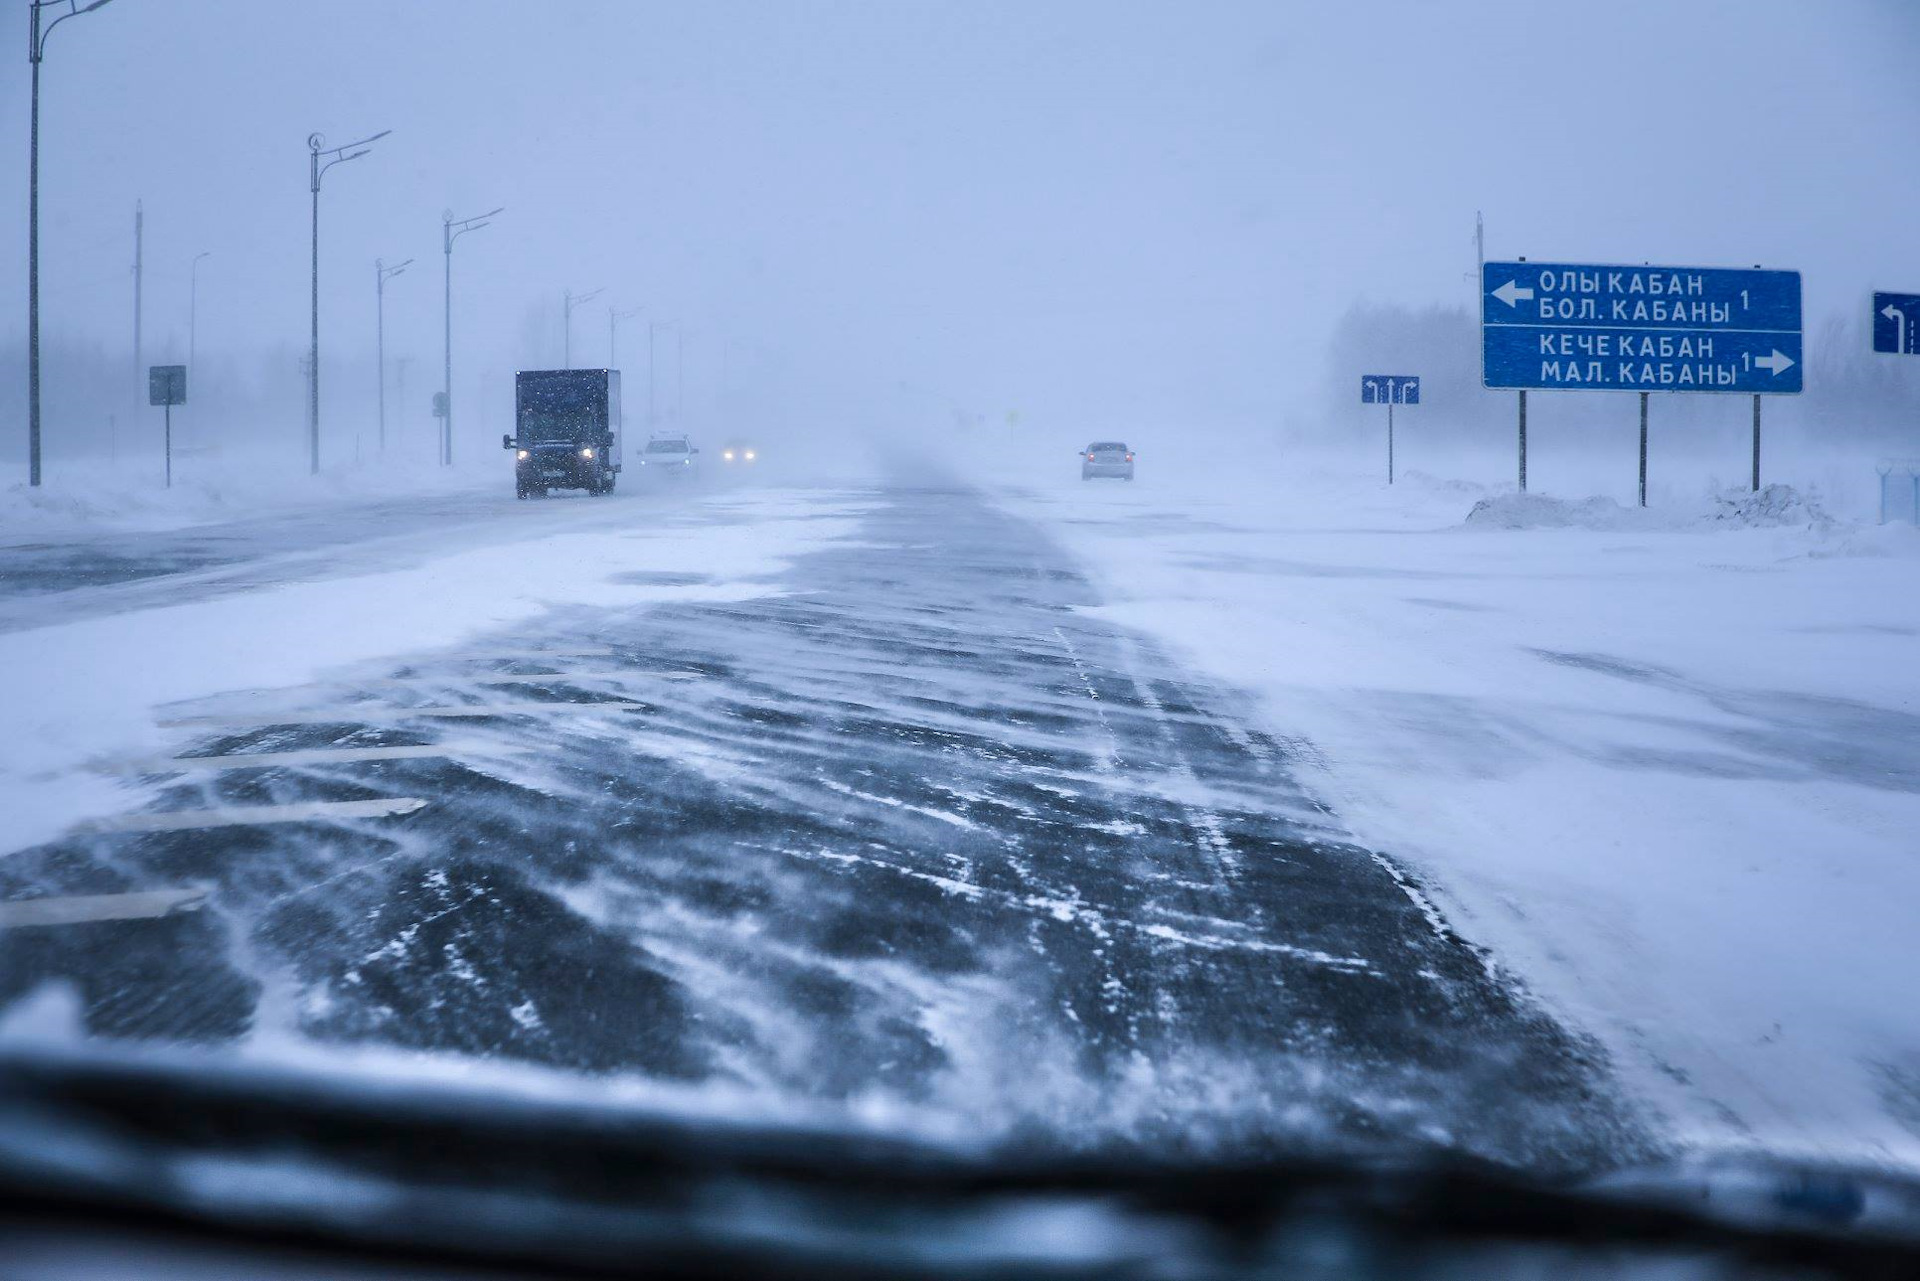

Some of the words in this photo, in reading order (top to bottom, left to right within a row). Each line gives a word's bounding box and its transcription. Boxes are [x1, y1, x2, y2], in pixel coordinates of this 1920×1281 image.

[1540, 271, 1599, 292] ОЛЫ
[1609, 273, 1702, 295] КАБАН
[1540, 297, 1603, 319] БОЛ.
[1613, 300, 1729, 322] КАБАНЫ
[1740, 289, 1749, 310] 1
[1540, 334, 1610, 356] КЕЧЕ
[1619, 336, 1713, 358] КАБАН
[1541, 361, 1610, 383] МАЛ.
[1620, 362, 1736, 385] КАБАНЫ
[1741, 351, 1749, 372] 1
